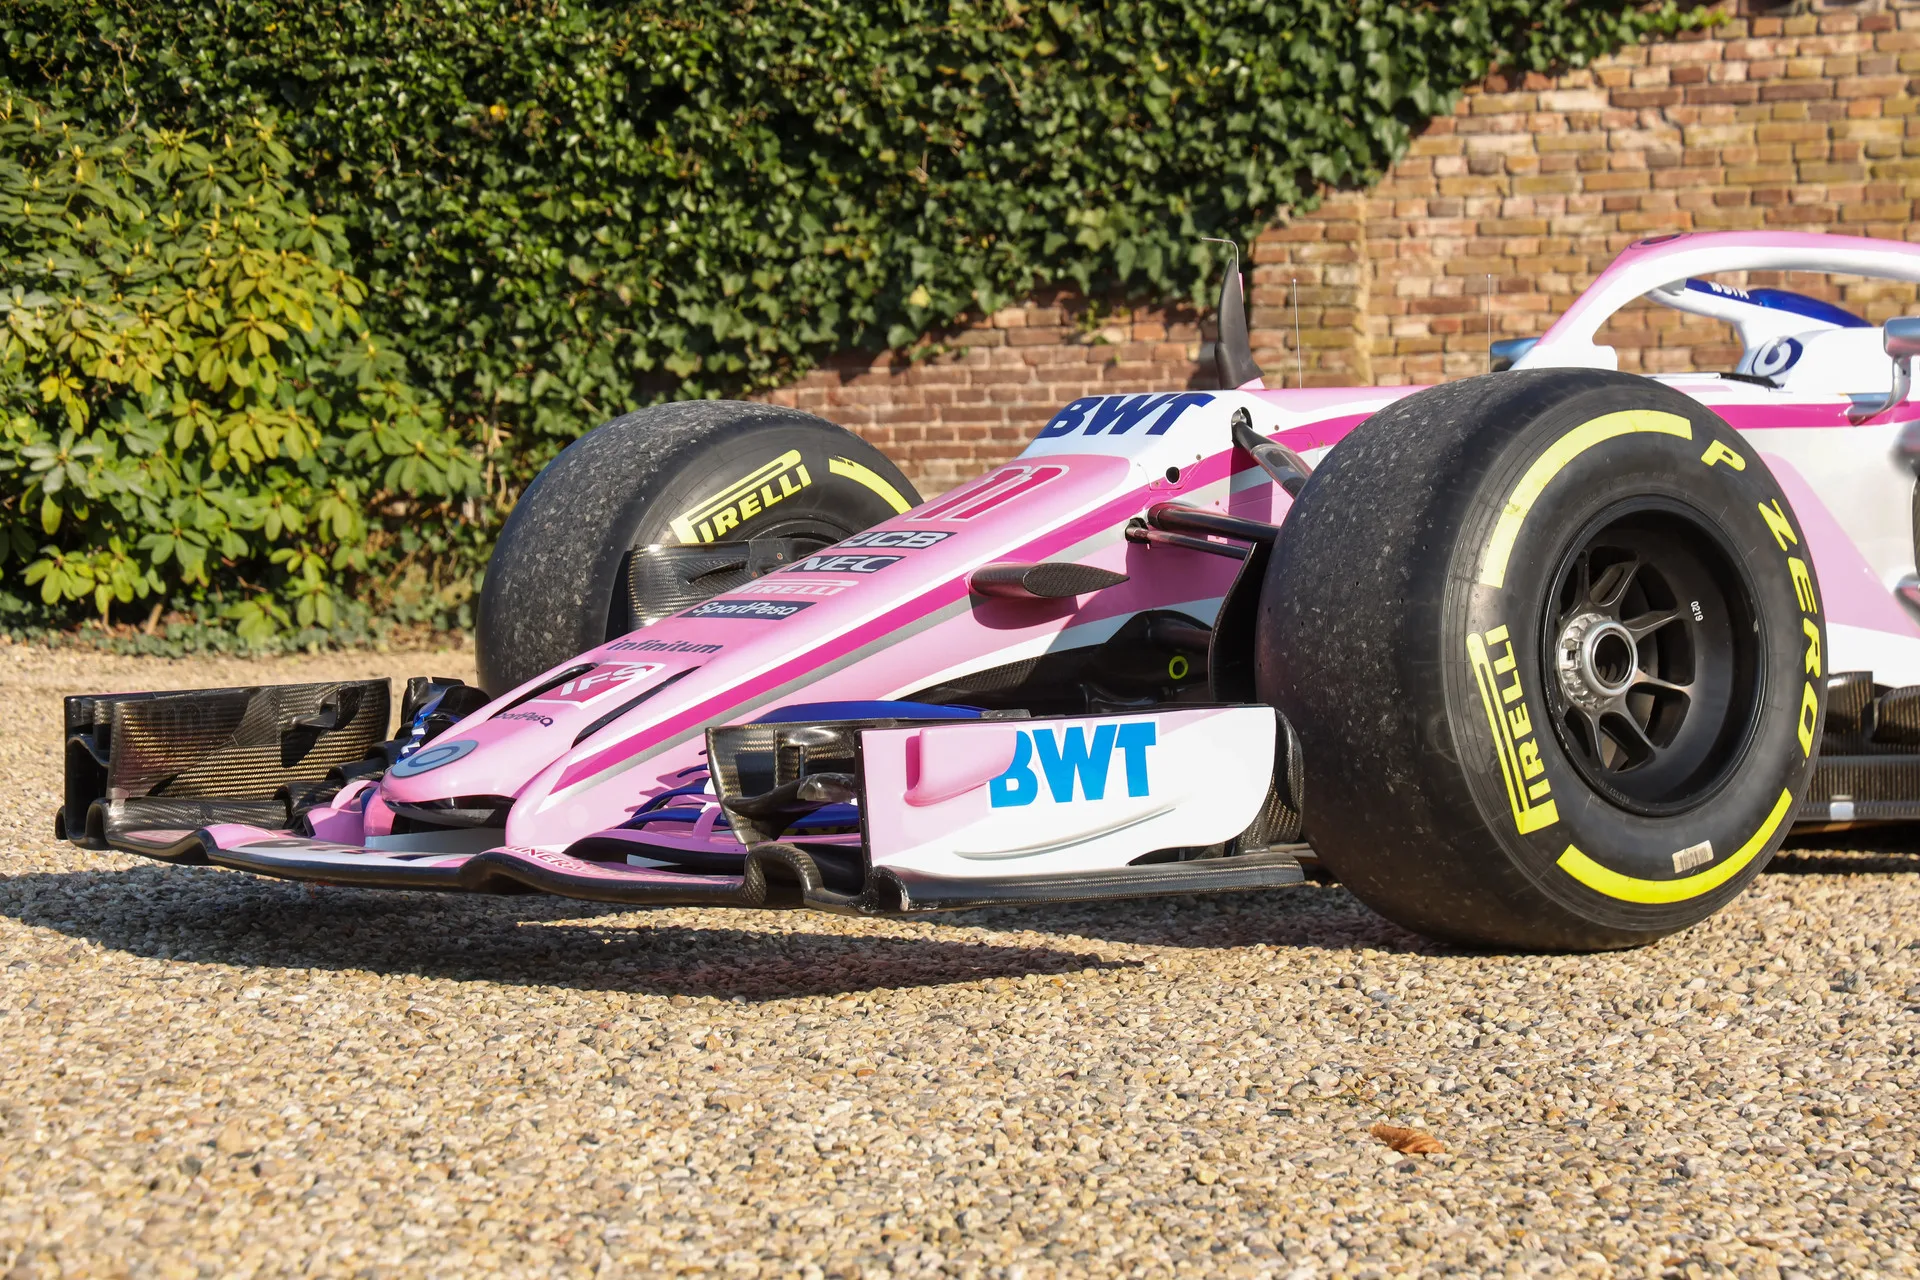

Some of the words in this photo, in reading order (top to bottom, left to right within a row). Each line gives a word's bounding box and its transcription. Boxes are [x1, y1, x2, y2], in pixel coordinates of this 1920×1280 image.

[1036, 392, 1216, 439] BWT
[669, 449, 812, 543] PIRELLI
[839, 531, 949, 548] JCB
[787, 555, 901, 572] NEC
[729, 579, 859, 596] PIRELLI
[1701, 439, 1746, 472] P
[1757, 498, 1822, 758] ZERO
[693, 601, 801, 617] SportPesa
[1690, 600, 1704, 622] 0219
[606, 638, 724, 654] infinitum
[560, 664, 647, 697] IFS
[1467, 624, 1560, 835] PIRELLI
[989, 721, 1157, 809] BWT
